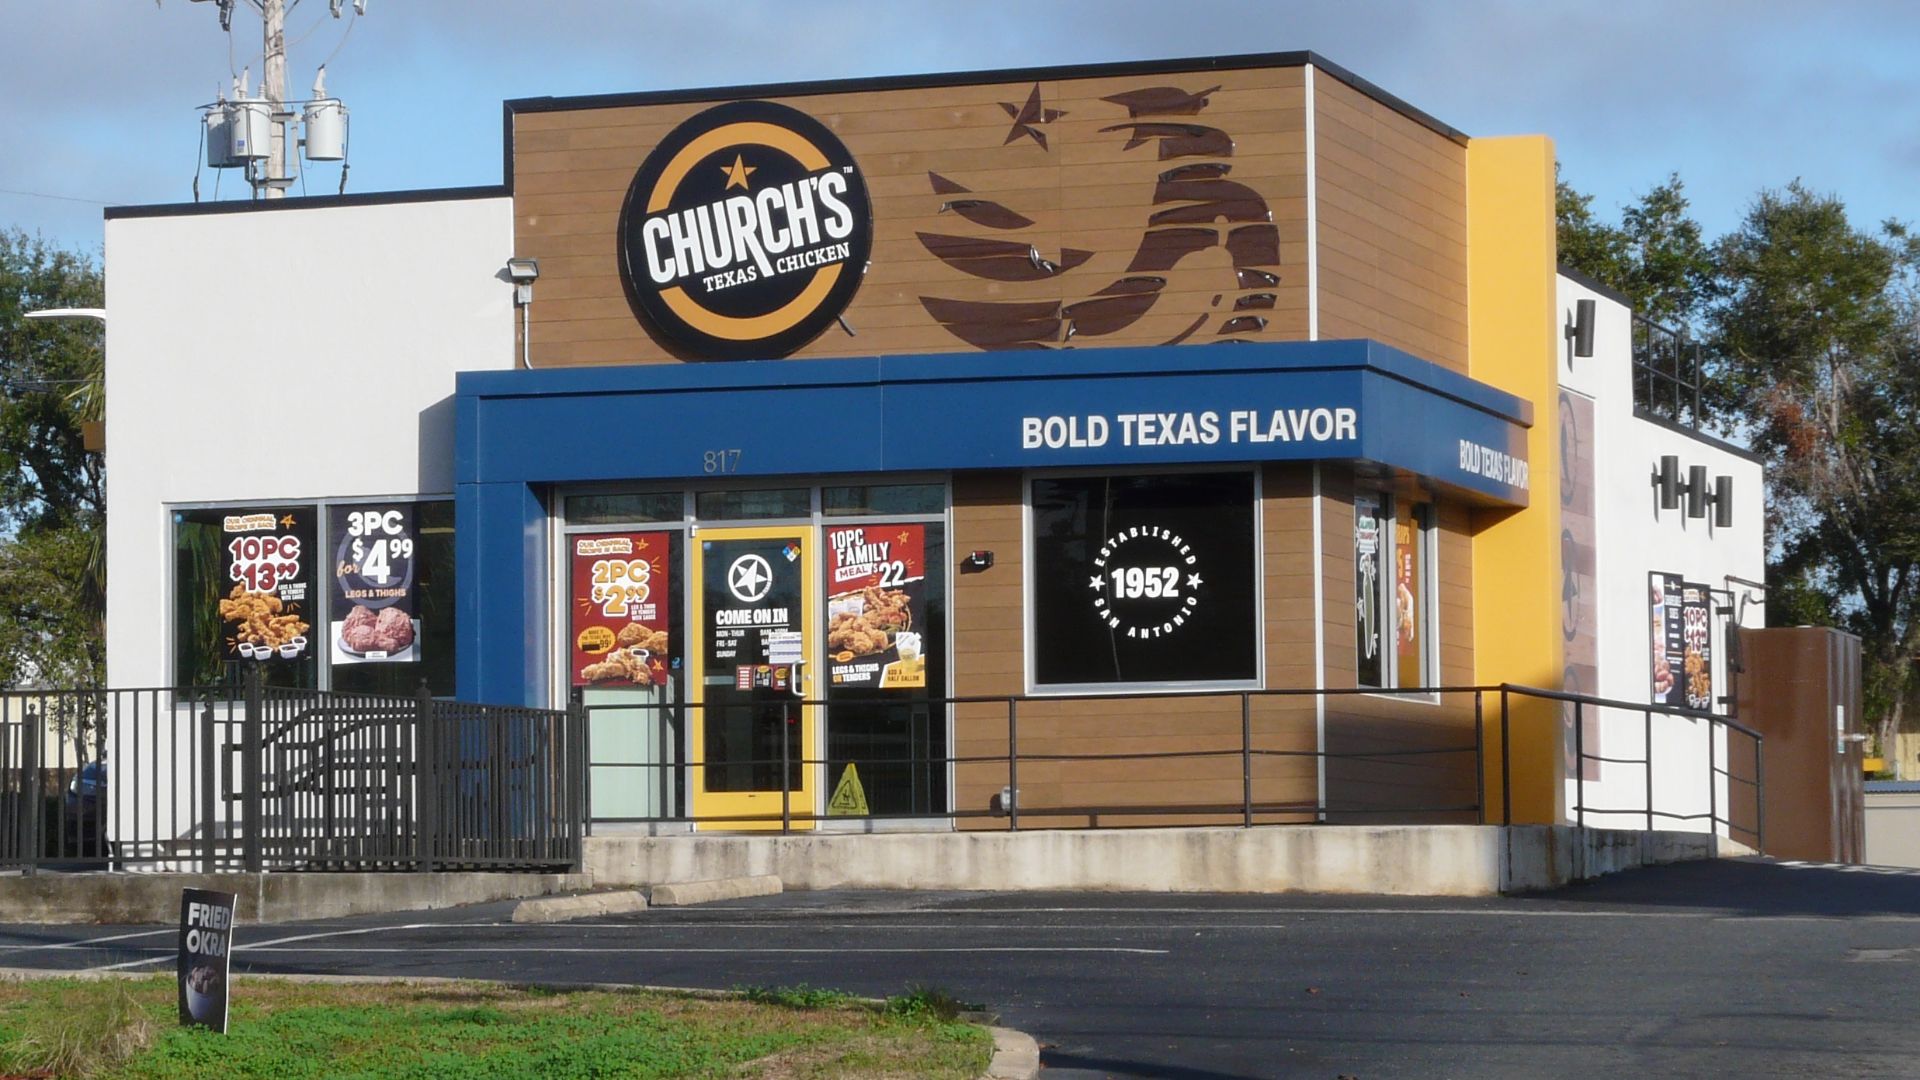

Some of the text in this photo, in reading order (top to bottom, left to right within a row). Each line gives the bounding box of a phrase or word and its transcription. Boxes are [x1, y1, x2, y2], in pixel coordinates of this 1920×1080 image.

[643, 172, 853, 283] CHURCH'S
[703, 242, 850, 292] TEXAS CHICKEN
[1022, 408, 1357, 449] BOLD TEXAS FLAVOR
[704, 449, 742, 473] 817
[1459, 439, 1529, 490] BOLD TEXAS FLAVOR
[347, 510, 404, 537] 3PC
[230, 537, 299, 561] 10PC
[830, 528, 864, 550] 10PC
[1094, 525, 1197, 567] ESTABLISHED
[836, 541, 889, 567] FAMILY
[336, 560, 360, 578] for
[594, 561, 648, 584] 2PC
[839, 565, 868, 579] MEAL
[345, 588, 406, 599] LEGS & THIGHS
[1111, 566, 1179, 599] 1952
[716, 608, 788, 625] COME ON IN
[1094, 596, 1197, 639] SAN ANTONIO
[716, 650, 736, 658] SUNDAY
[832, 663, 879, 675] LEGS & THIGHS
[843, 672, 871, 682] TENDERS
[187, 902, 230, 930] FRIED
[186, 929, 226, 957] OKRA
